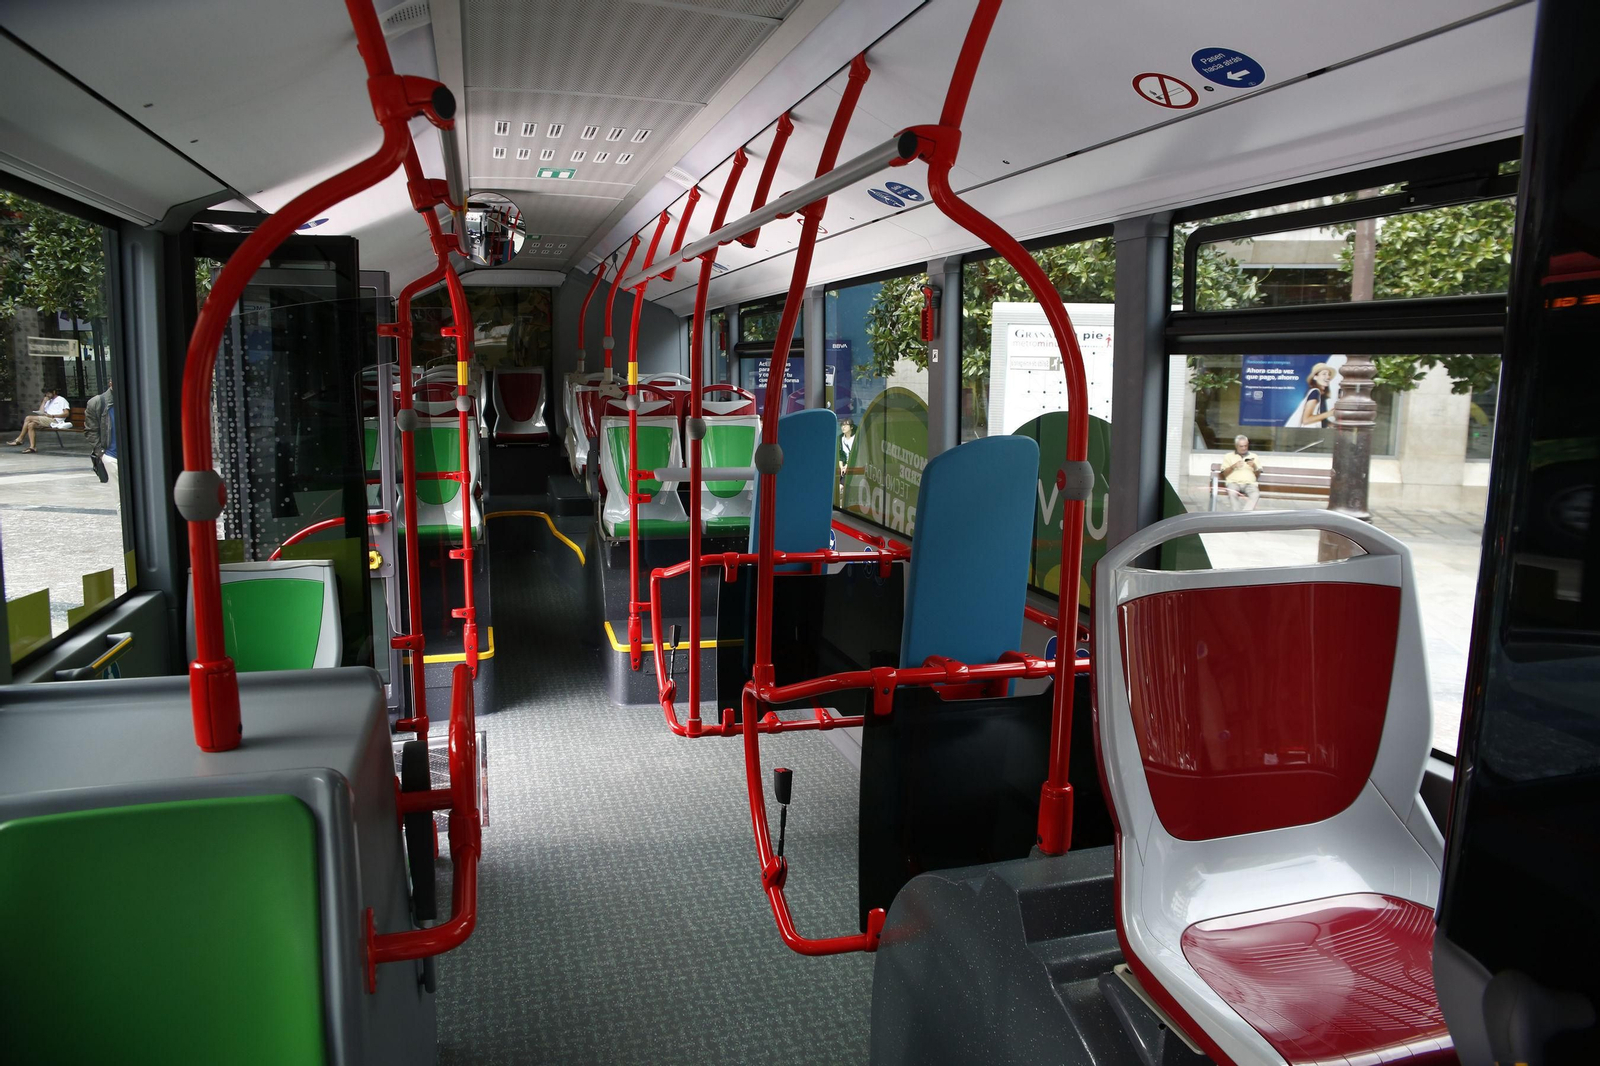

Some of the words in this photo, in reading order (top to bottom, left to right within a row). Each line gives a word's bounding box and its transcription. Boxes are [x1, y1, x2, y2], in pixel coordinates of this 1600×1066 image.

[1200, 53, 1225, 64] Pasen
[1202, 63, 1224, 73] hacia
[1222, 56, 1243, 66] atrás
[1014, 329, 1054, 339] GRANA
[1083, 331, 1103, 341] pie
[1012, 339, 1059, 348] metrominu
